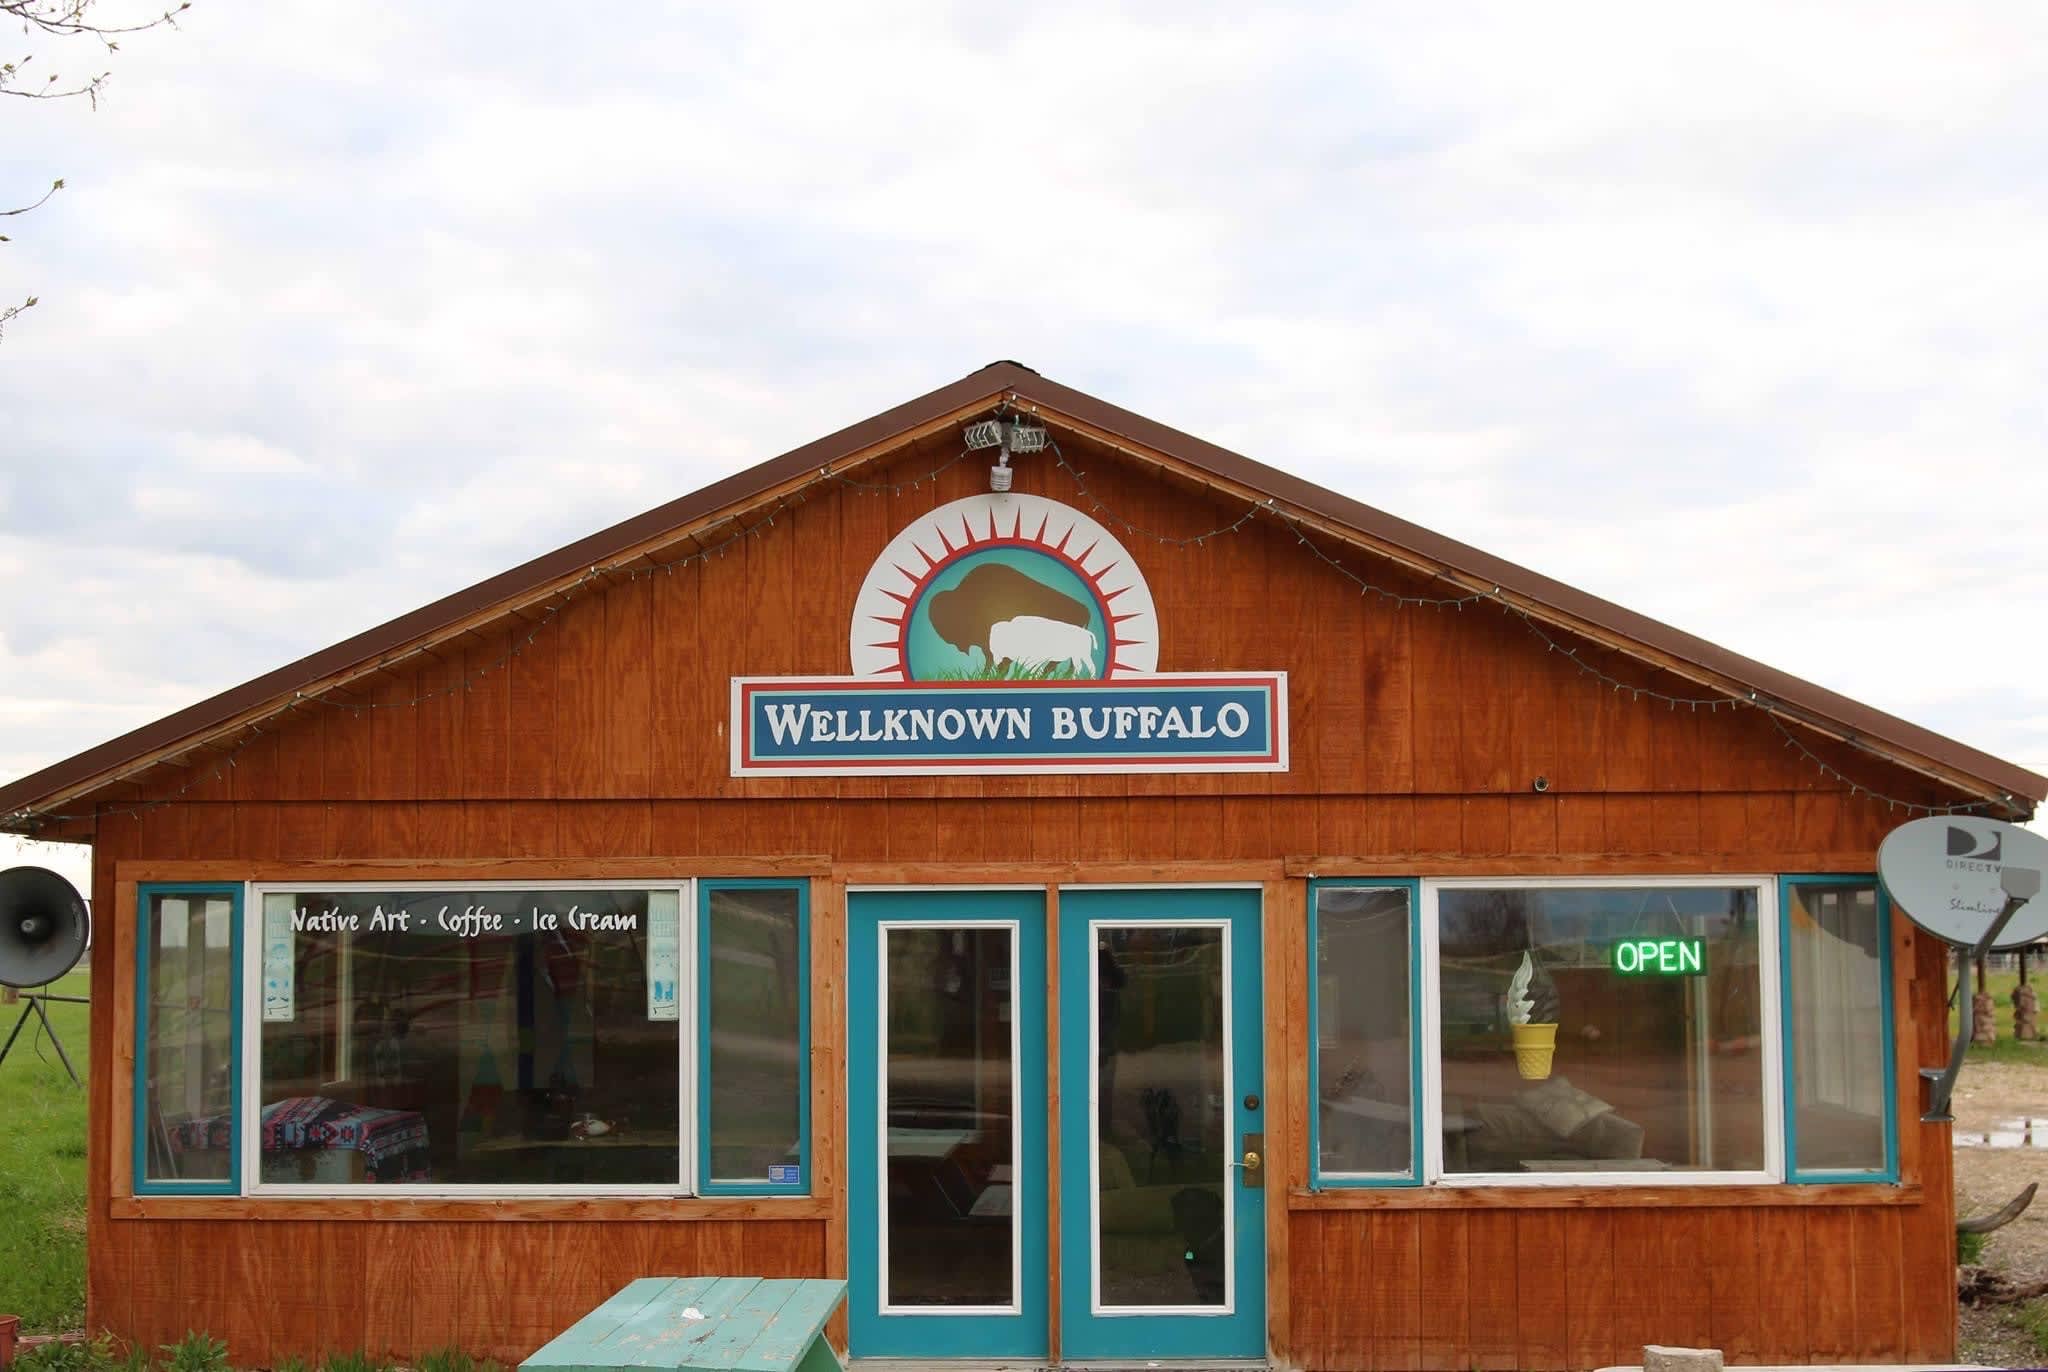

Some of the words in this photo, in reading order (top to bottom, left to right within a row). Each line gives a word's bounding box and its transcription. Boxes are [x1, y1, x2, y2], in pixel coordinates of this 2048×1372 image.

[764, 702, 1031, 745] WELLKNOWN
[1052, 702, 1250, 740] BUFFALO
[289, 906, 359, 932] Native
[369, 905, 410, 931] Art
[438, 905, 503, 937] Coffee
[533, 906, 558, 930] Ice
[568, 905, 637, 931] Cream
[1617, 941, 1700, 972] OPEN
